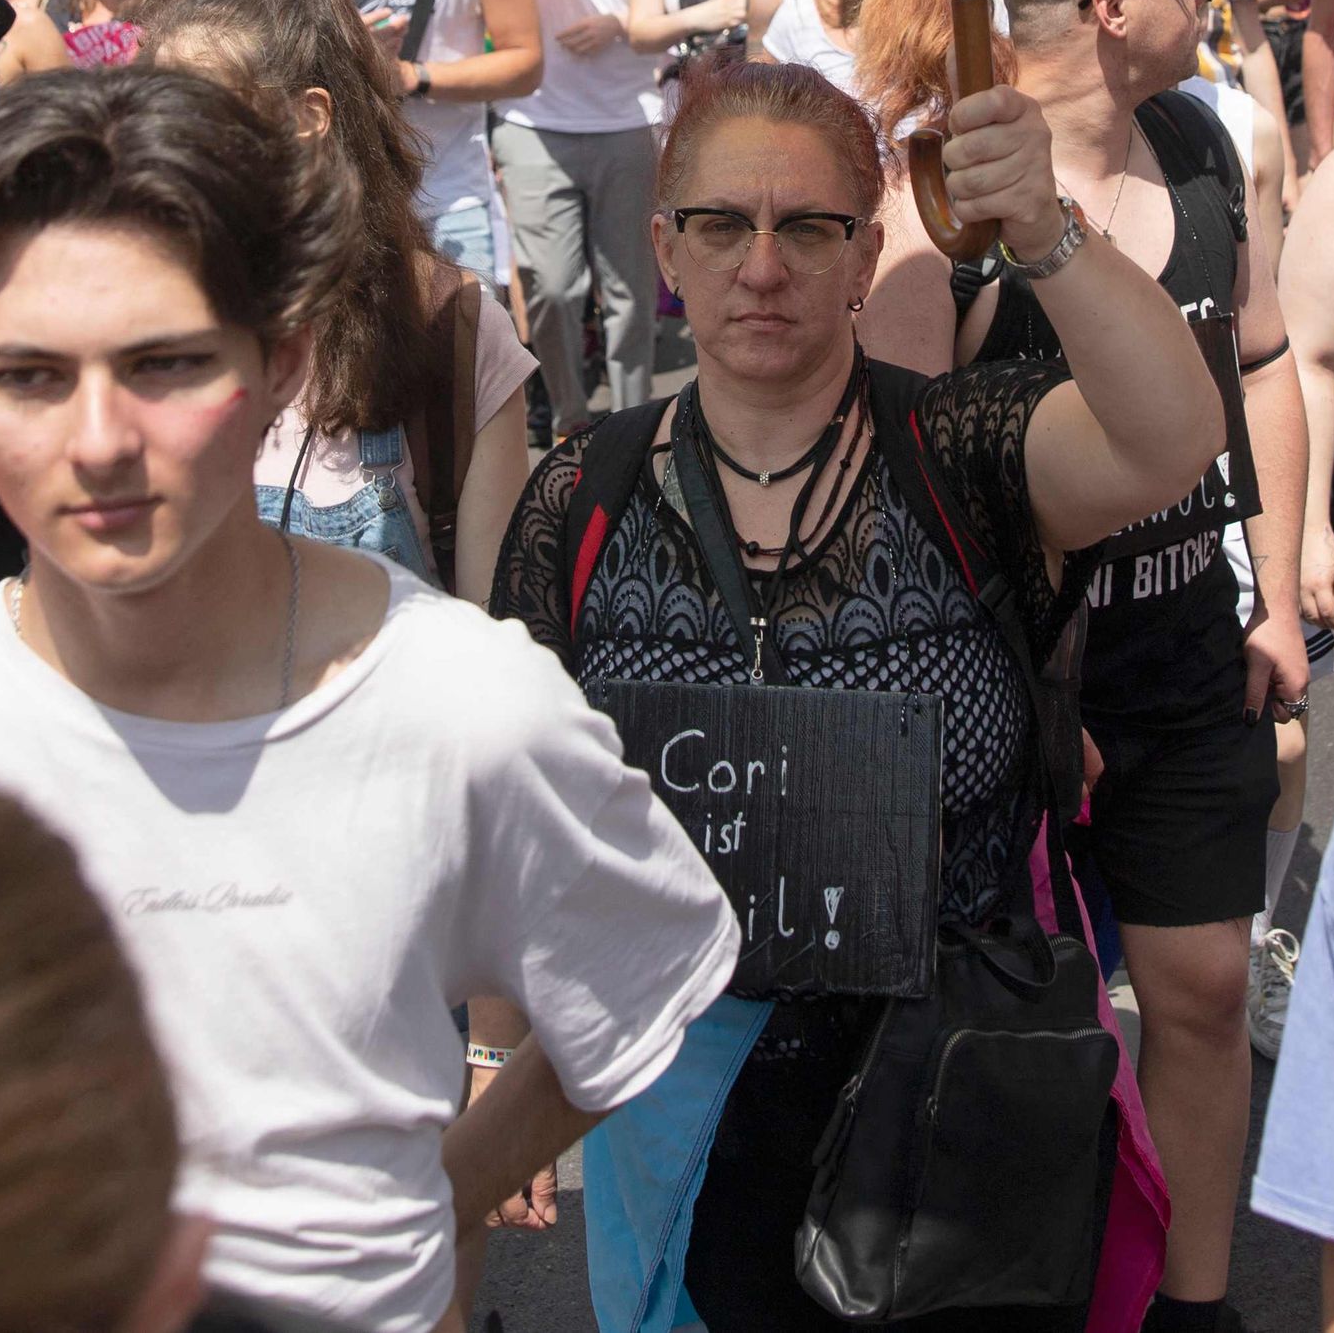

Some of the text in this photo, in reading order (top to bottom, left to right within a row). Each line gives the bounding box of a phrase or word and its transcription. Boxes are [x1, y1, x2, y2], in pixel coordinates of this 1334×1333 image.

[661, 728, 788, 796] Cori
[704, 812, 746, 854] ist
[747, 876, 845, 951] il!
